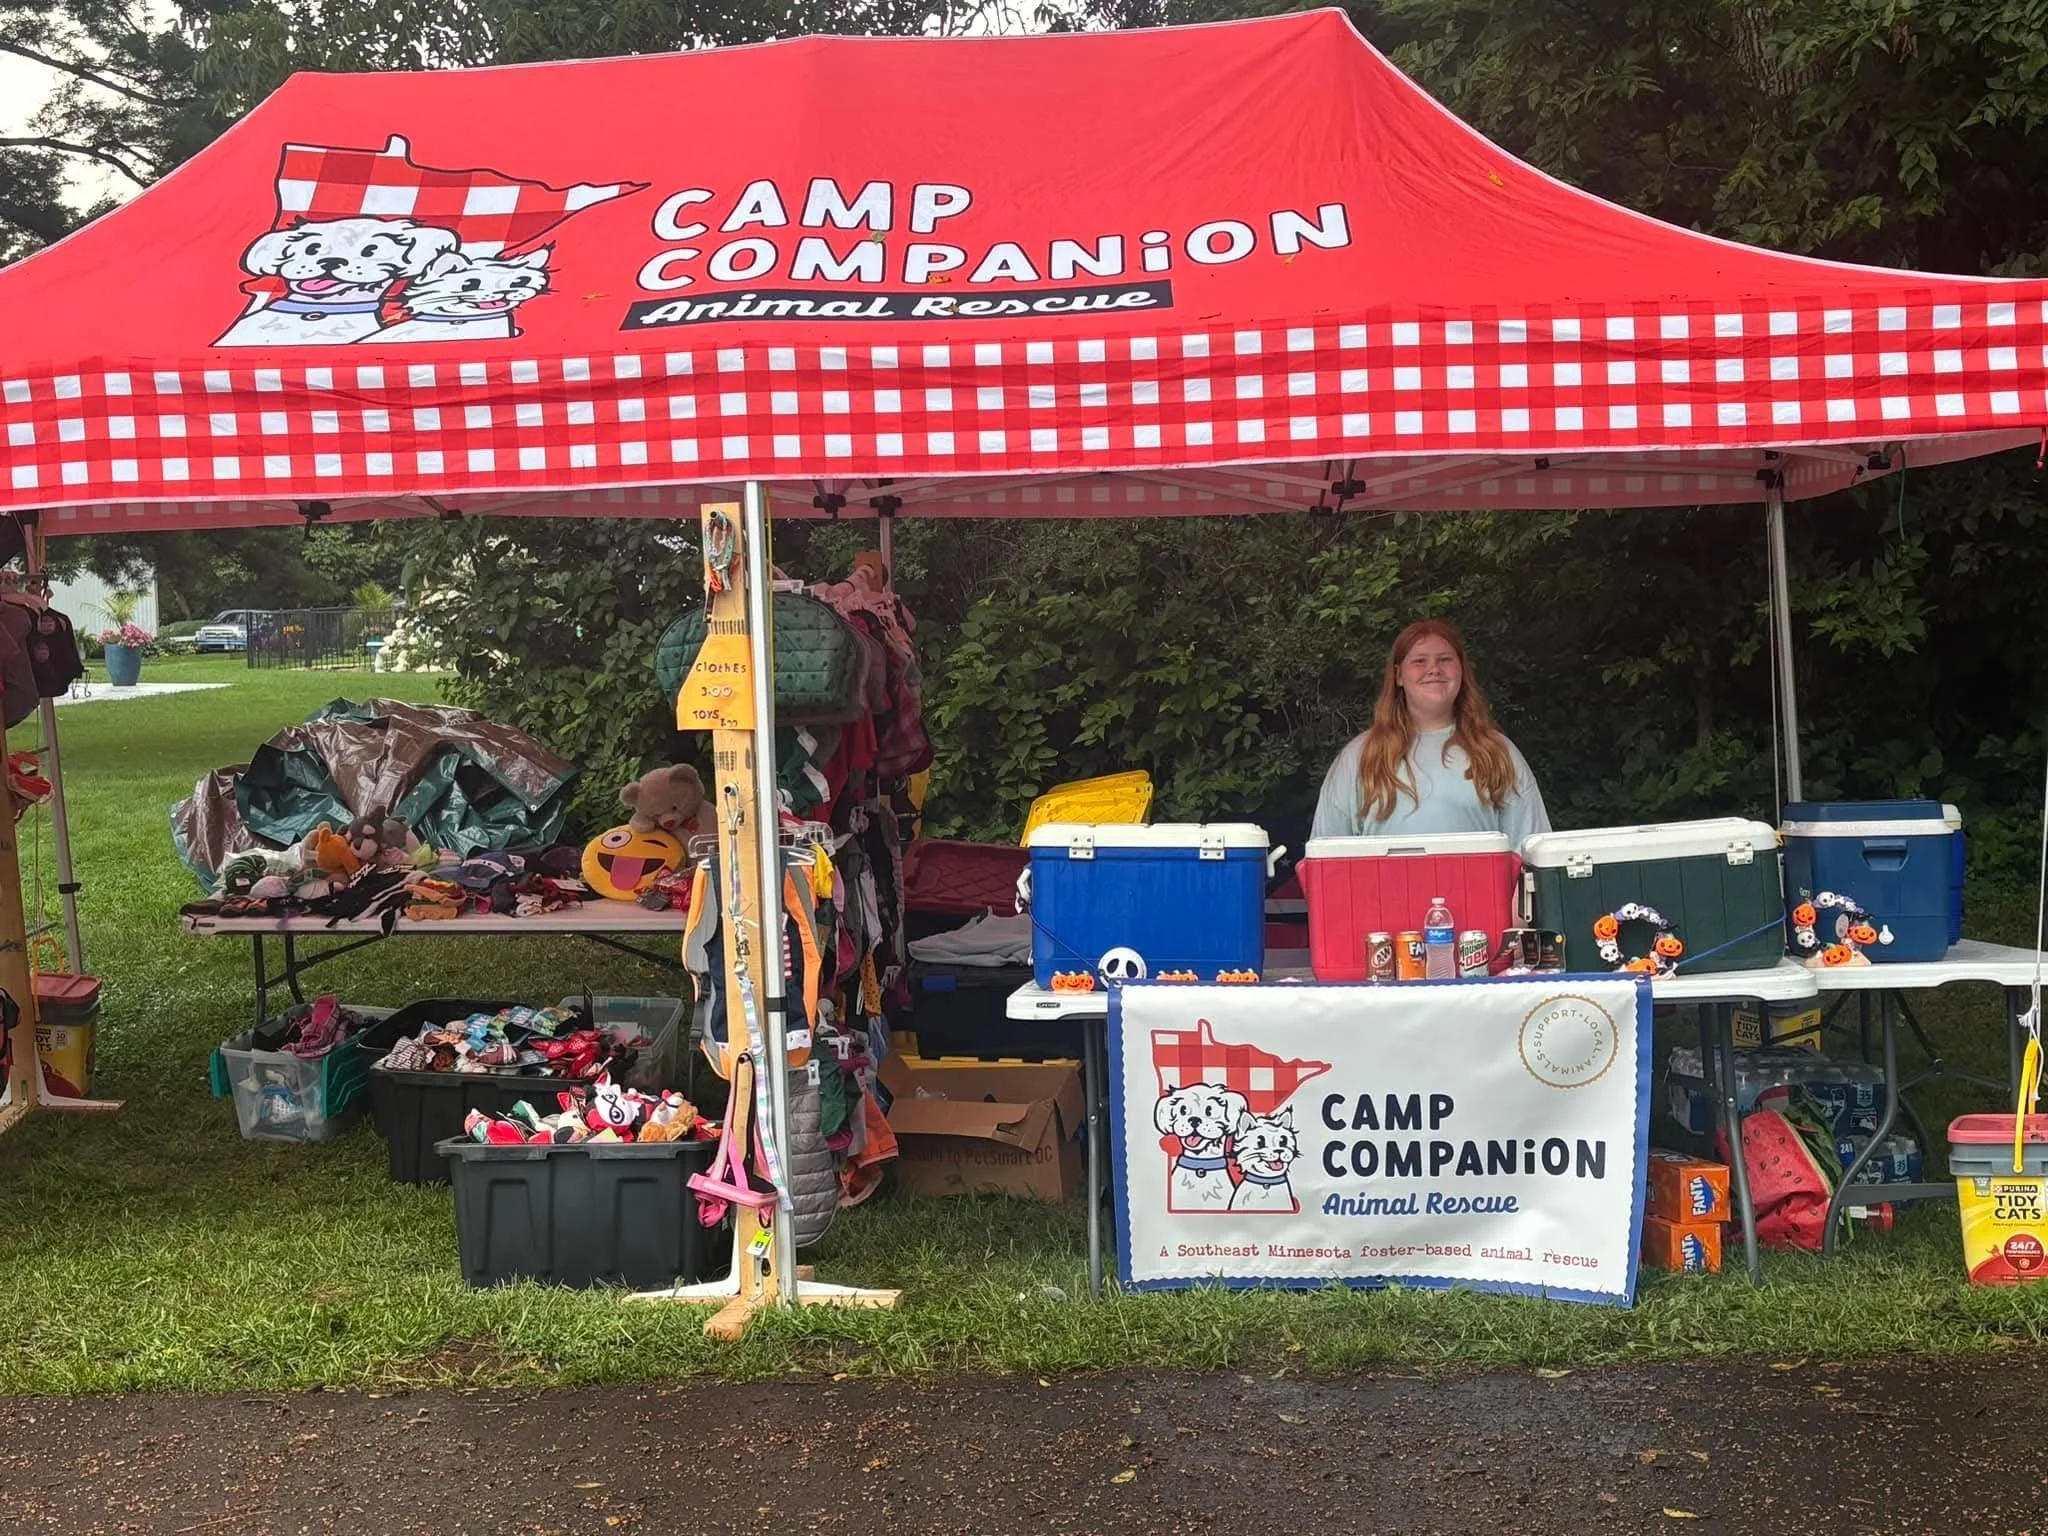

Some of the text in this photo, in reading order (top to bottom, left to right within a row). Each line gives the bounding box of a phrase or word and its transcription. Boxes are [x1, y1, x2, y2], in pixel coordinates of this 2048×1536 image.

[653, 178, 972, 241] CAMP
[639, 288, 1159, 326] Animal Rescue
[1735, 1021, 1759, 1033] TIDY
[1533, 1009, 1604, 1075] SUPPORT LOCAL ANIMALS
[1321, 1093, 1455, 1131] CAMP
[1689, 1175, 1707, 1217] FANTA
[1994, 1195, 2038, 1207] TIDY
[2002, 1185, 2038, 1193] PURINA
[1322, 1191, 1520, 1217] Animal Rescue
[1994, 1208, 2041, 1220] CATS
[1160, 1244, 1600, 1269] A Southeast Minnesota foster-based animal rescue
